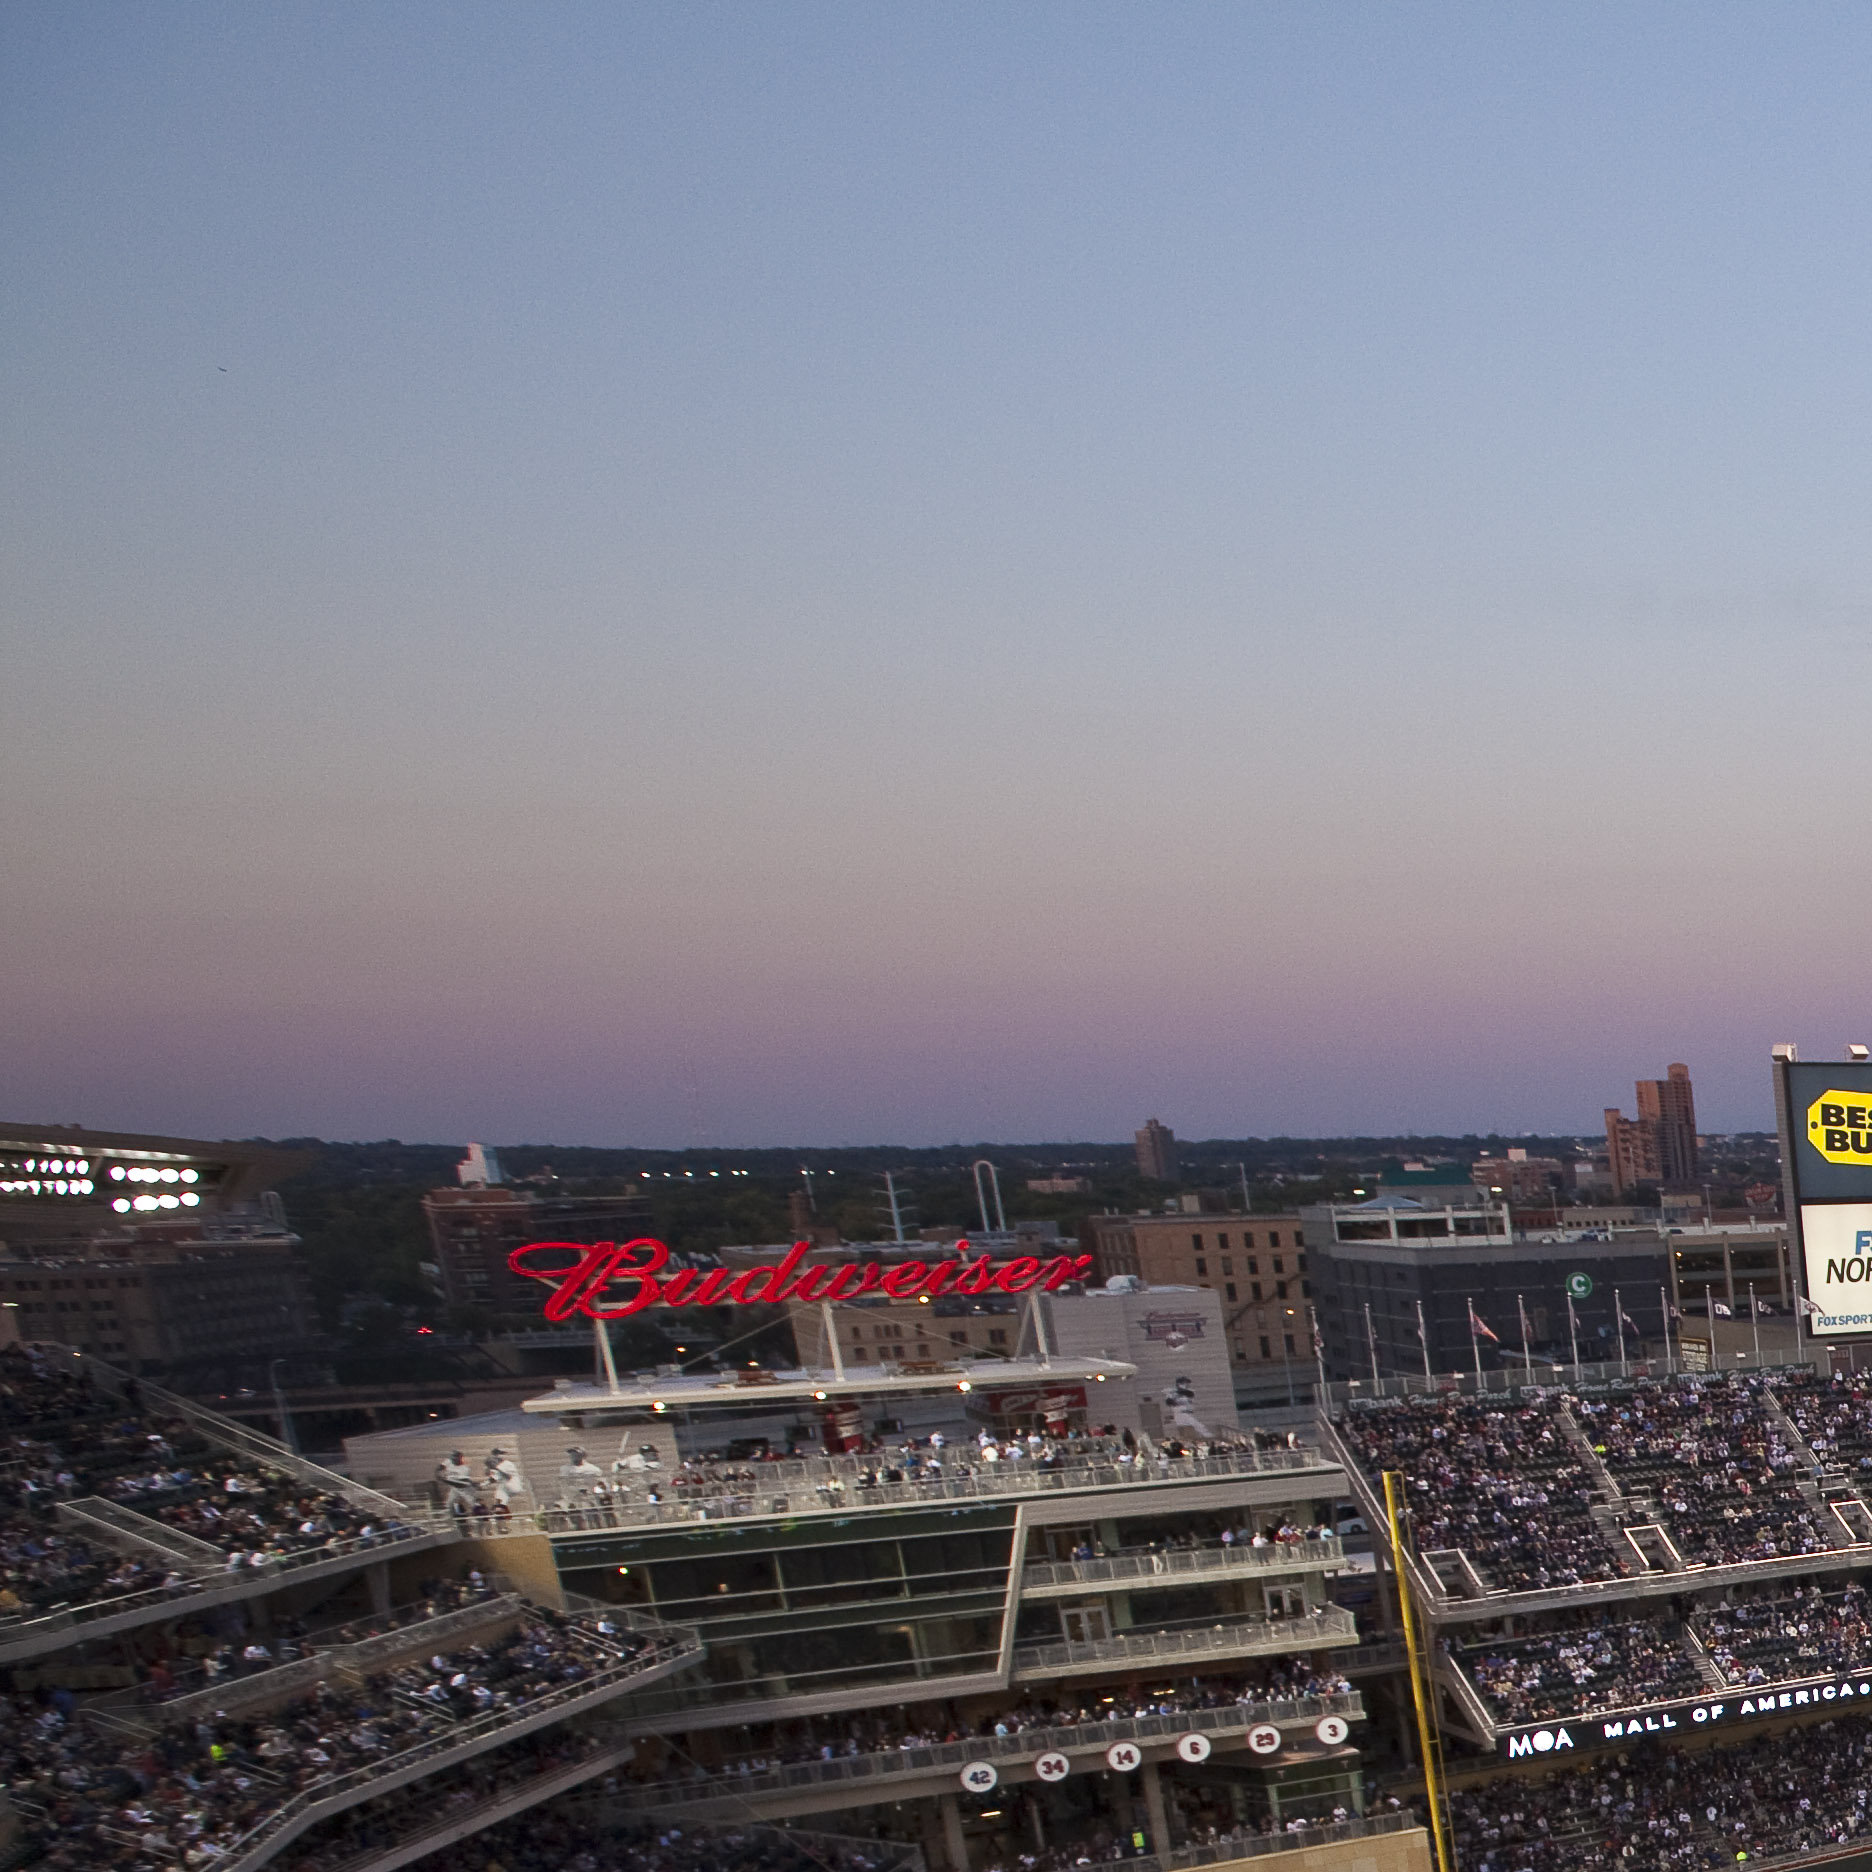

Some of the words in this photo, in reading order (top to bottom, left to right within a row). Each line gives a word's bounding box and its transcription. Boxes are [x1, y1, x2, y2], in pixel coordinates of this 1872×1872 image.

[507, 1237, 1092, 1321] Budweiser
[969, 1770, 990, 1785] 42
[1042, 1759, 1064, 1775] 34
[1116, 1750, 1134, 1765] 14
[1190, 1741, 1200, 1755] 6
[1328, 1724, 1338, 1738] 3
[1509, 1727, 1574, 1758] MOA
[1603, 1715, 1676, 1739] MALL
[1692, 1704, 1725, 1724] OF
[1740, 1684, 1854, 1715] AMERICA
